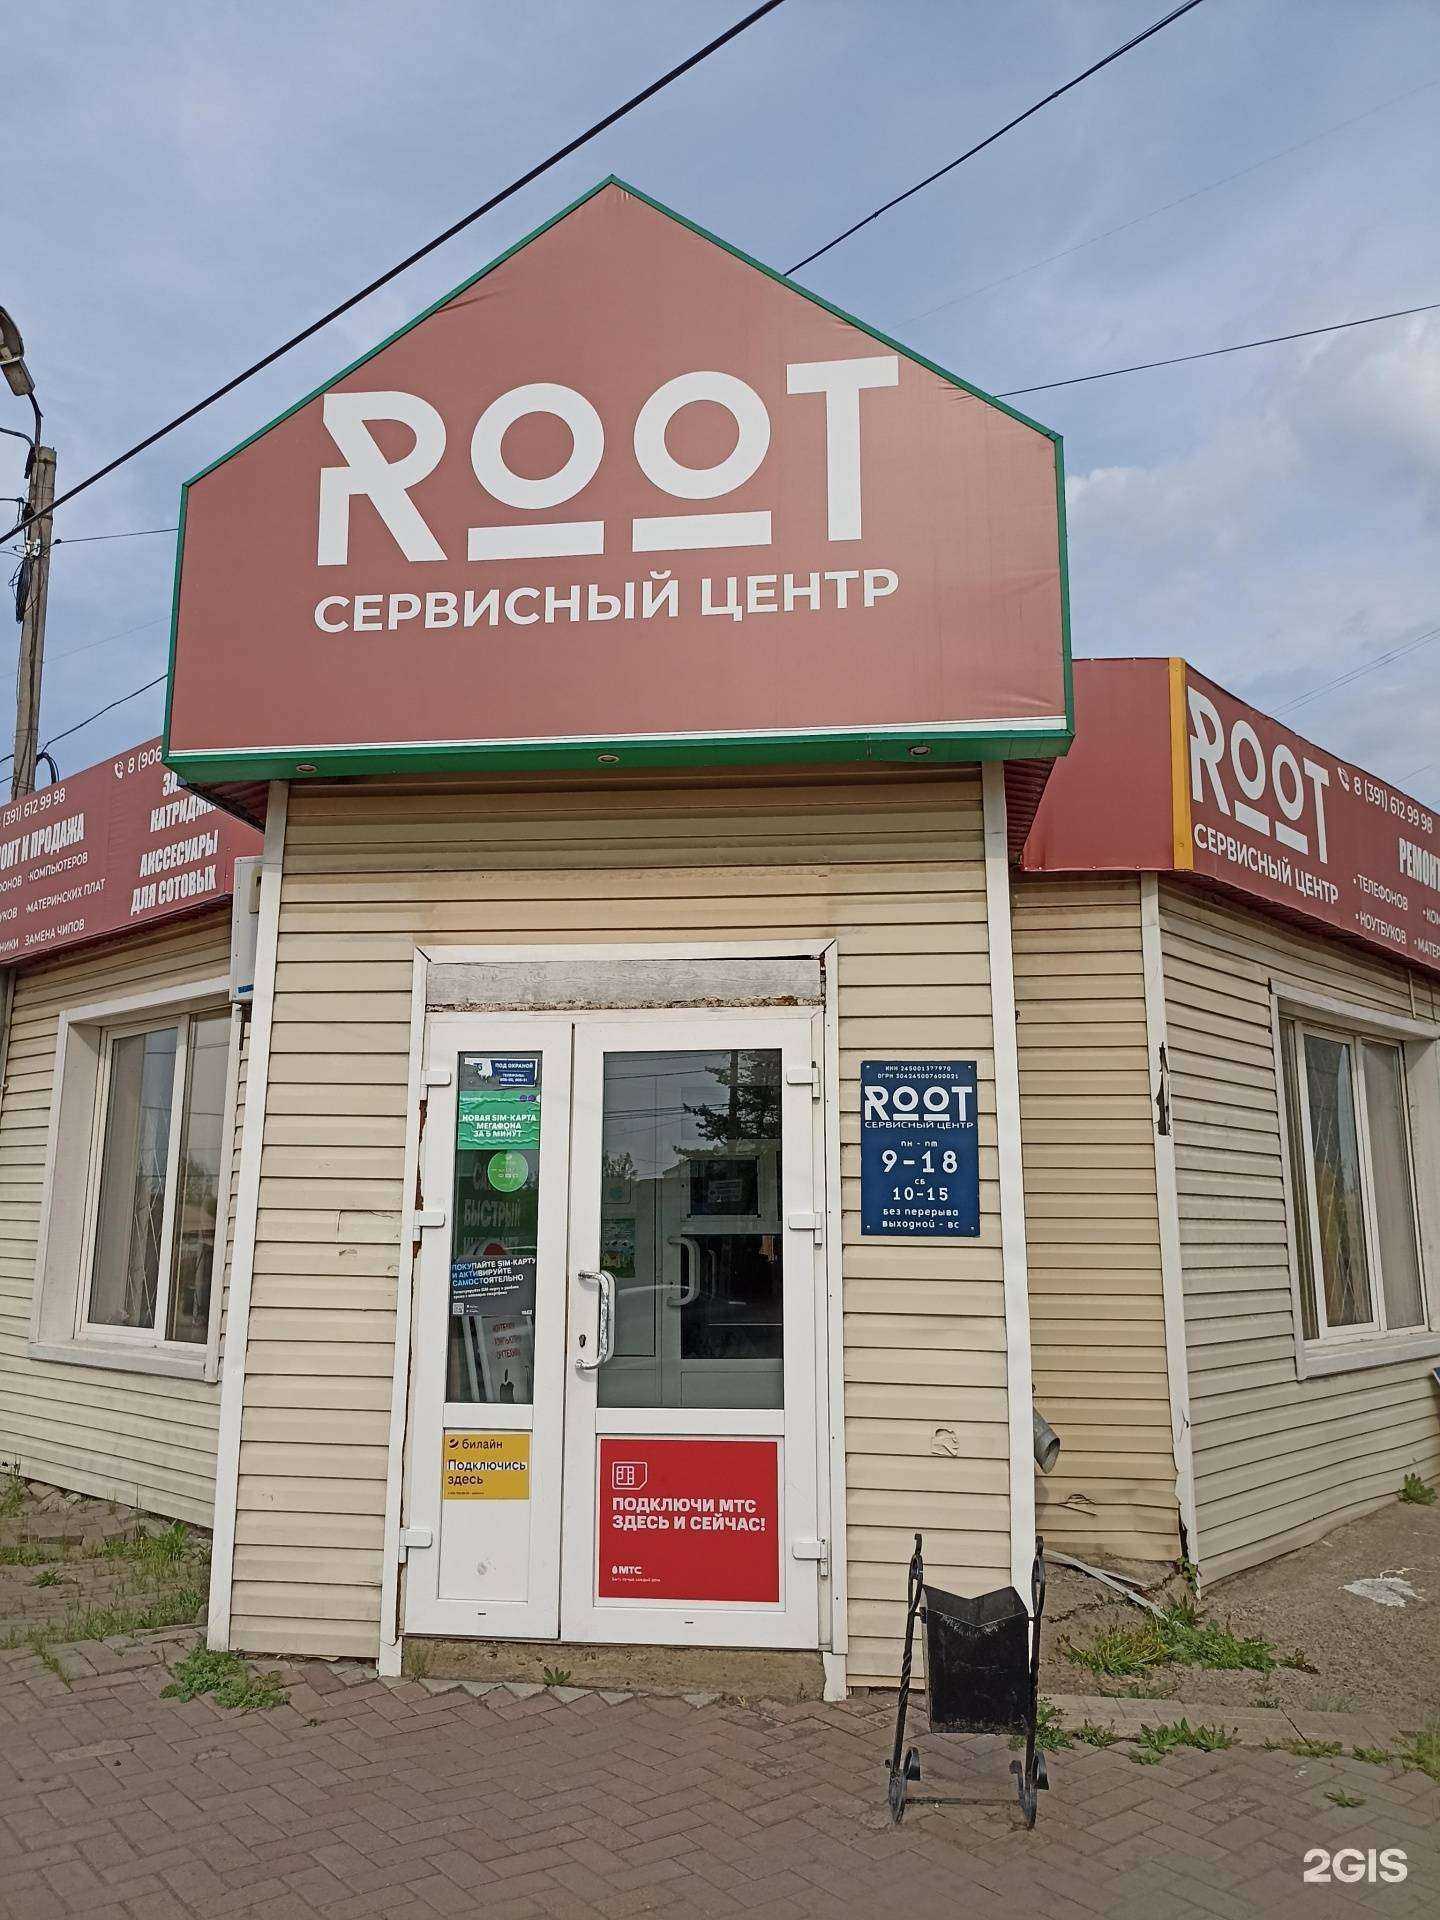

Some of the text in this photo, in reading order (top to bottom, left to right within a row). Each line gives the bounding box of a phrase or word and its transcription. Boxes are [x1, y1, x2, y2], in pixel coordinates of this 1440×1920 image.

[317, 355, 899, 566] ROOT
[313, 568, 899, 634] СЕРВИСНЫЙ ЦЕНТР
[128, 757, 135, 773] 8
[1187, 685, 1330, 864] ROOT
[2, 787, 66, 828] (391) 612 99 98
[1354, 776, 1433, 834] 8 (391) 612 99 98
[0, 812, 84, 870] ОНТ И ПРОДАЖА
[29, 851, 88, 882] КОМПЬЮТЕРОВ
[1193, 823, 1339, 904] СЕРВИСНЫЙ ЦЕНТР
[27, 886, 83, 914] МАТЕРИНСКИХ
[83, 878, 106, 897] ПЛАТ
[130, 864, 217, 917] ДЛЯ СОТОВЫХ
[1357, 873, 1409, 911] ТЕЛЕФОНОВ
[25, 928, 56, 946] ЗАМЕНА
[57, 918, 85, 937] ЧИПОВ
[1360, 911, 1407, 945] НОУТБУКОВ
[864, 1085, 973, 1121] ROOT
[476, 1122, 522, 1130] МЕГАФОНА
[492, 1130, 522, 1138] МИНУТ
[864, 1120, 974, 1131] СЕРВИСНЫЙ ЦЕНТР
[904, 1208, 959, 1217] перерыва
[452, 1257, 537, 1271] ПОКУПАЙТЕ SIM-КАРТУ
[458, 1266, 512, 1278] АКТИВИРУЙТЕ
[452, 1273, 524, 1287] САМОСТОЯТЕЛЬНО
[461, 1438, 504, 1450] билайн
[447, 1459, 527, 1472] Подключись
[447, 1475, 484, 1486] здесь
[611, 1497, 757, 1514] ПОДКЛЮЧИ МТС
[611, 1513, 767, 1532] ЗДЕСЬ И СЕЙЧАС!
[618, 1565, 643, 1575] МТС
